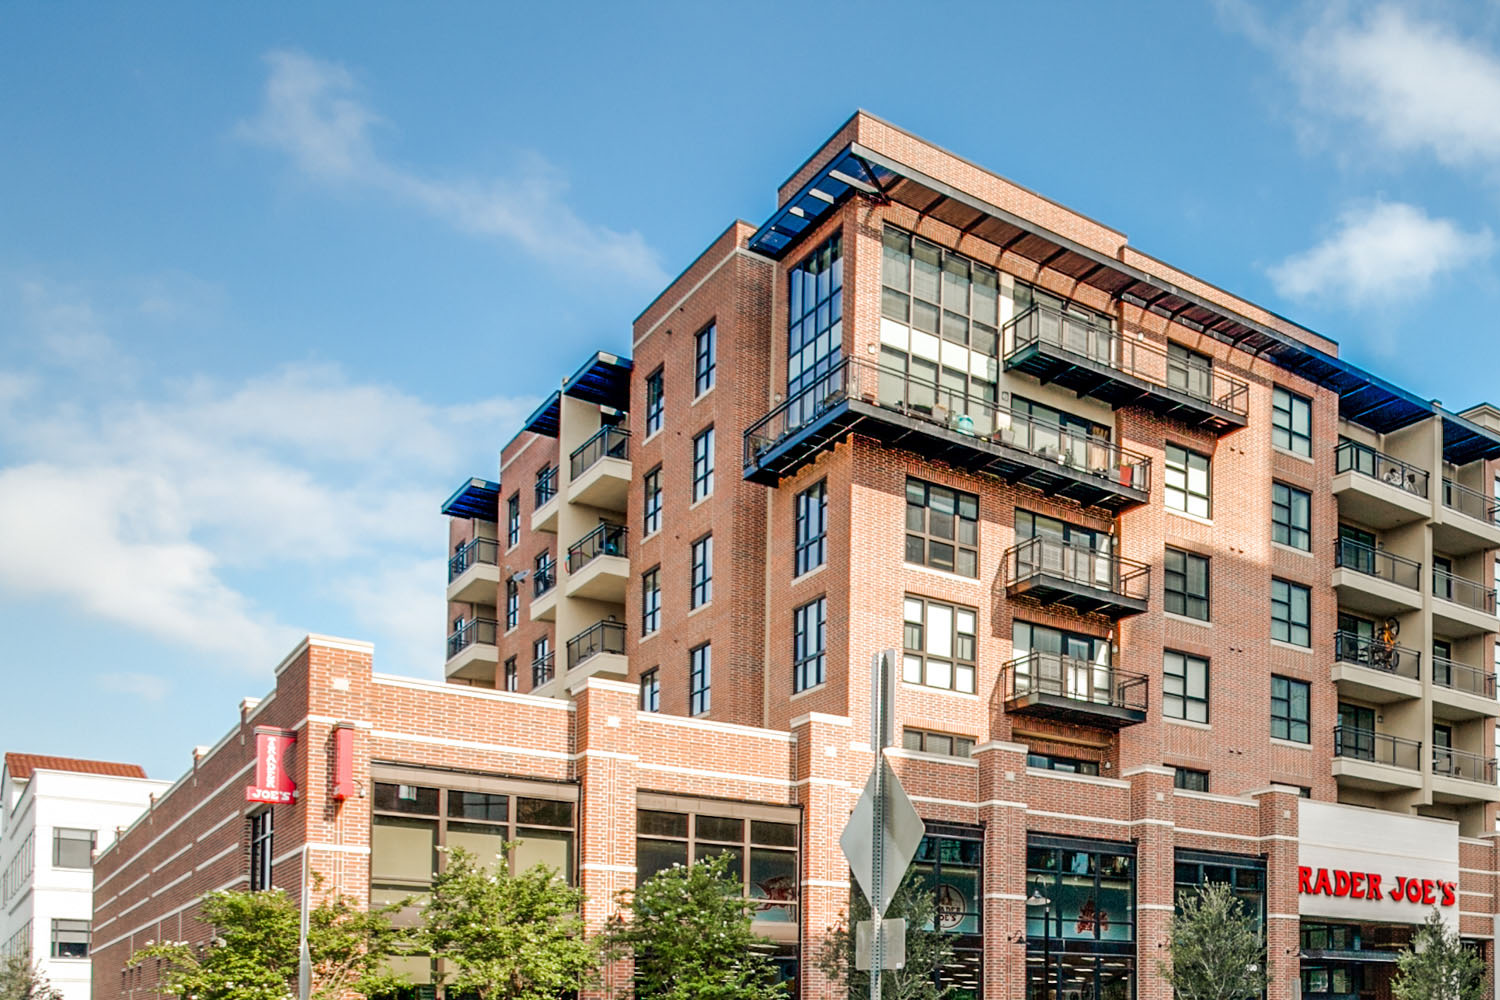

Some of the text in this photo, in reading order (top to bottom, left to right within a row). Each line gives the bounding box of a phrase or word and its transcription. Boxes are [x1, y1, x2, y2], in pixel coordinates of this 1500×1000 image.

[265, 736, 277, 788] TRADER
[251, 788, 291, 801] JOE'S
[1388, 876, 1457, 906] JOE'S
